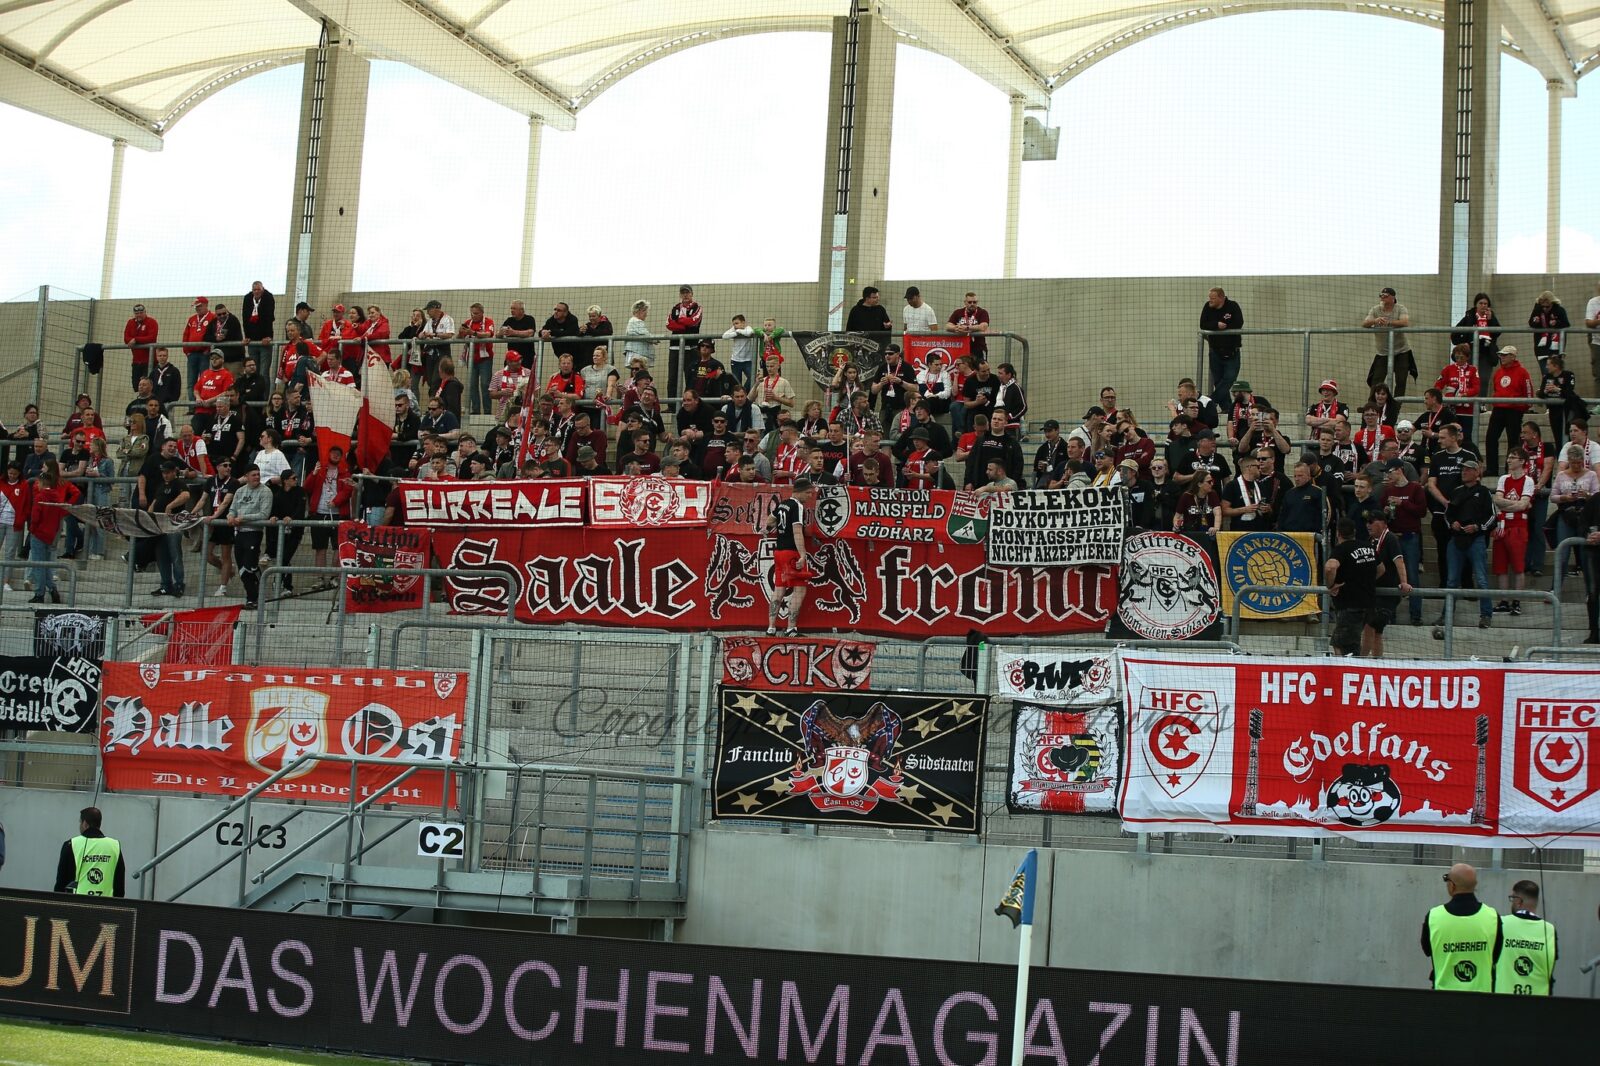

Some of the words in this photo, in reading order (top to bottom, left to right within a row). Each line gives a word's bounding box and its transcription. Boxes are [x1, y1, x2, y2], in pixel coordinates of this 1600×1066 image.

[646, 483, 665, 491] HFC
[870, 487, 930, 502] SEKTION
[404, 487, 582, 521] SURREALE
[989, 487, 1121, 511] TELEKOM
[855, 501, 946, 520] MANSFELD
[992, 507, 1122, 529] BOYKOTTIEREN
[857, 522, 934, 542] SÜDHARZ
[991, 528, 1122, 546] MONTAGSSPIELE
[991, 545, 1033, 562] NICHT
[1034, 544, 1121, 562] AKZEPTIEREN
[1127, 534, 1201, 558] Ultras
[1235, 537, 1304, 569] FANSZENE
[396, 554, 418, 563] HFC
[446, 537, 699, 620] Saale
[876, 545, 1112, 625] front
[1151, 566, 1175, 577] HFC
[67, 657, 98, 684] HFC
[762, 643, 838, 688] CTK
[0, 668, 60, 695] Crew
[161, 669, 427, 689] Fanclub
[1260, 671, 1318, 706] HFC
[1340, 672, 1482, 709] FANCLUB
[1151, 691, 1204, 712] HFC
[1523, 704, 1597, 728] HFC
[103, 695, 236, 756] Halle
[341, 702, 463, 761] Ost
[1037, 735, 1065, 746] HFC
[725, 745, 792, 764] Fanclub
[836, 750, 860, 759] HFC
[1282, 720, 1453, 784] Edelfans
[905, 753, 975, 773] Südstaaten
[152, 772, 208, 785] Die
[215, 821, 244, 847] C2
[257, 824, 287, 849] C3
[419, 825, 463, 856] C2
[1443, 941, 1488, 954] SICHERHEIT
[1505, 938, 1545, 951] SICHERHEIT
[155, 928, 315, 1018] DAS
[353, 946, 1242, 1066] WOCHENMAGAZIN
